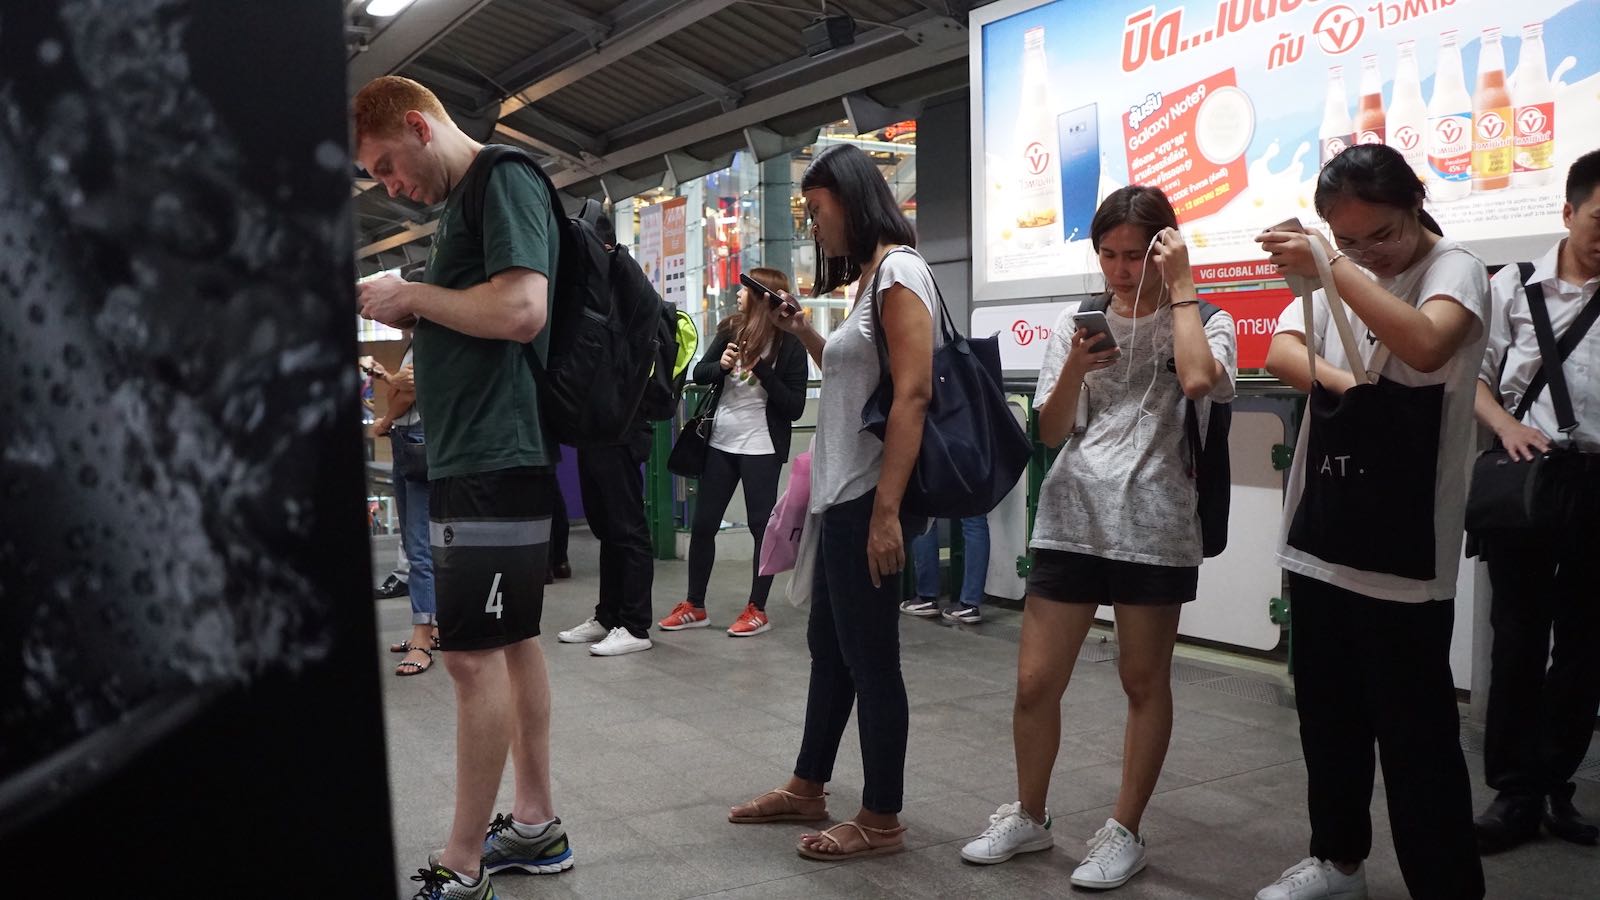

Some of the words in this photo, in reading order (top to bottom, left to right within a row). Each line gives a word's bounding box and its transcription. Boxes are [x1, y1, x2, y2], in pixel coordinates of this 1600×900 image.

[1268, 33, 1304, 70] กับ
[1129, 114, 1170, 150] Galaxy
[1169, 84, 1206, 120] Note9
[1200, 269, 1216, 279] VGI
[1217, 266, 1254, 278] GLOBAL
[484, 572, 504, 620] 4
